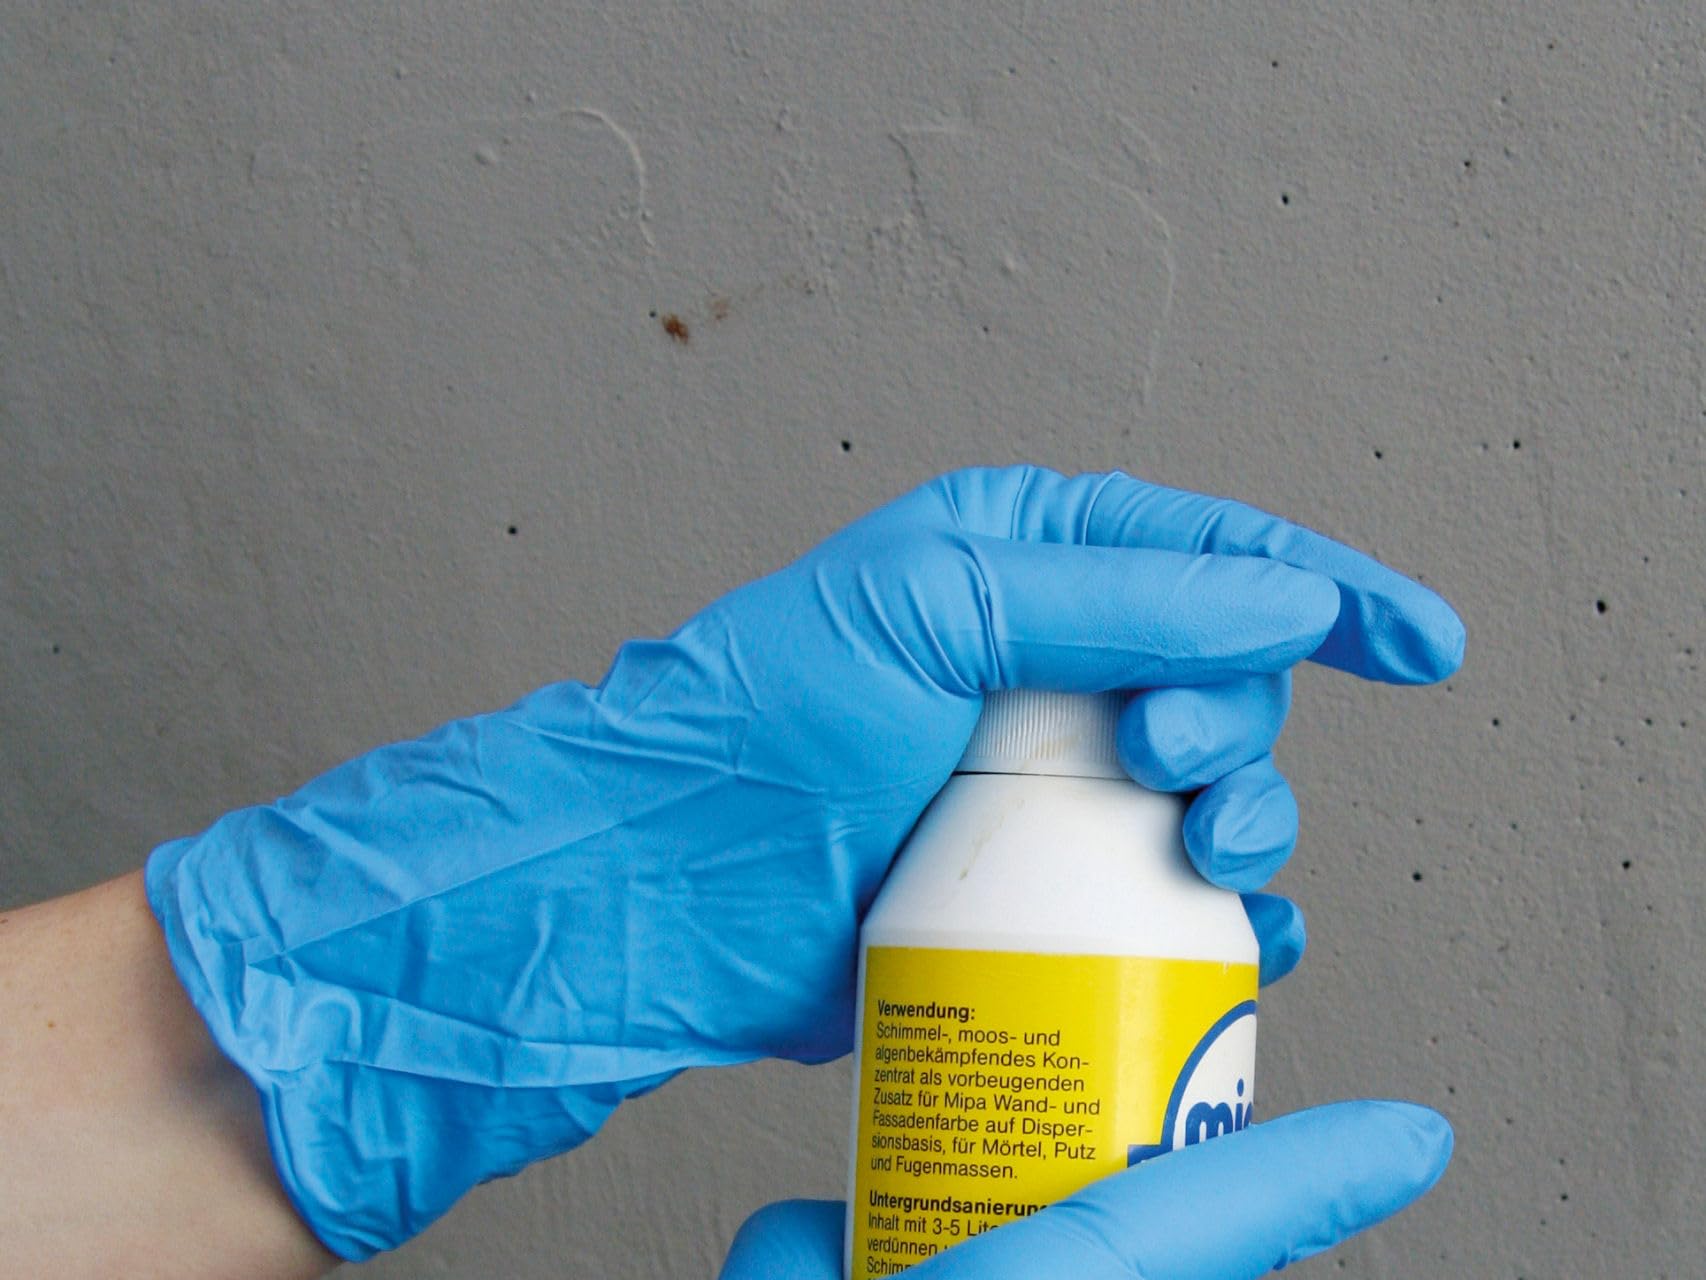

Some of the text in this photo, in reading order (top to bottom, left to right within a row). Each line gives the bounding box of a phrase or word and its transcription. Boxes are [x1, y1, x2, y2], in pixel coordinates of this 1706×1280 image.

[877, 1000, 975, 1022] Verwendung:
[876, 1021, 1060, 1046] Schimmel-, moos- und
[875, 1047, 1089, 1069] algenbekämpfendes Kon-
[874, 1069, 1085, 1092] zentrat als vorbeugenden
[873, 1088, 1100, 1115] Zusatz für Mipa Wand- und
[1185, 1078, 1253, 1147] mi
[872, 1110, 1093, 1138] Fassadenfarbe auf Disper-
[871, 1133, 1096, 1160] sionsbasis, für Mörtel, Putz
[871, 1156, 1018, 1179] und Fugenmassen.
[869, 1190, 1048, 1216] Untergrundsanierun
[868, 1212, 899, 1231] Inhalt
[904, 1217, 927, 1233] mit
[932, 1218, 960, 1236] 3-5
[867, 1236, 938, 1256] verdünnen
